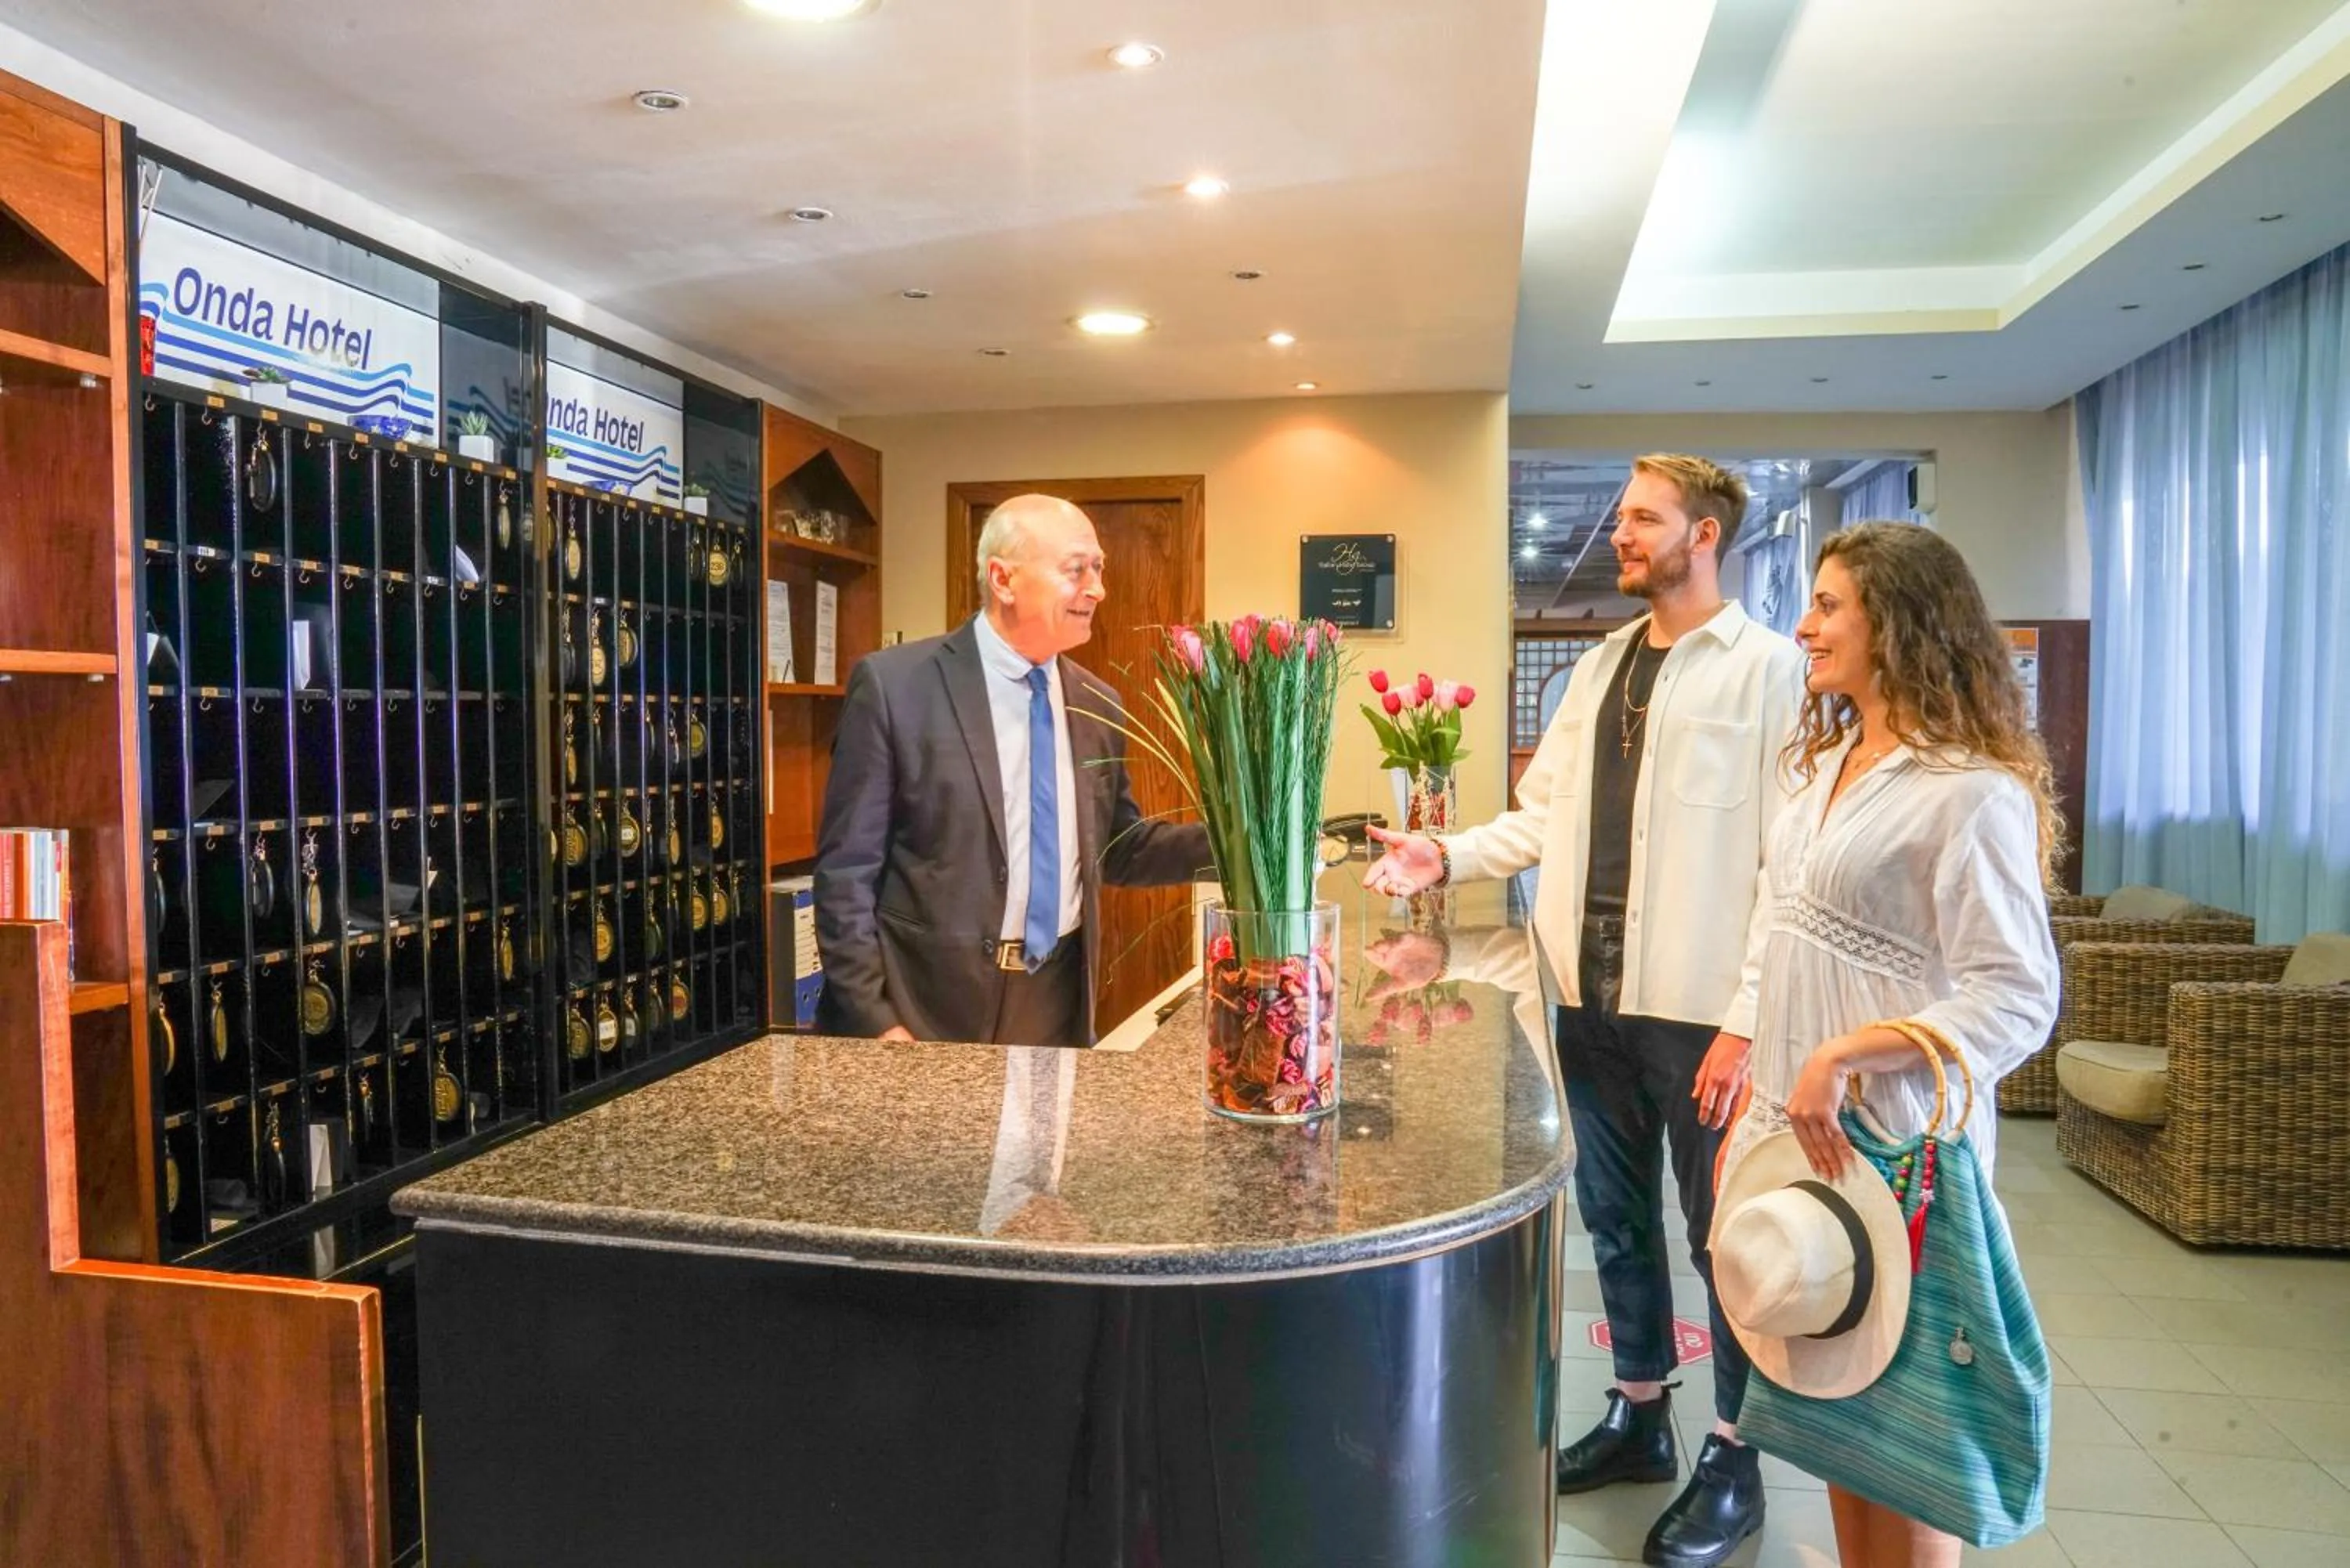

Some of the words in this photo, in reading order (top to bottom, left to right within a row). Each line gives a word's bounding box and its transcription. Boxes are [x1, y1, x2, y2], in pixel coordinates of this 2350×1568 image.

[174, 267, 274, 341] Onda
[283, 303, 373, 370] Hotel
[546, 394, 588, 436] nda
[594, 407, 645, 453] Hotel
